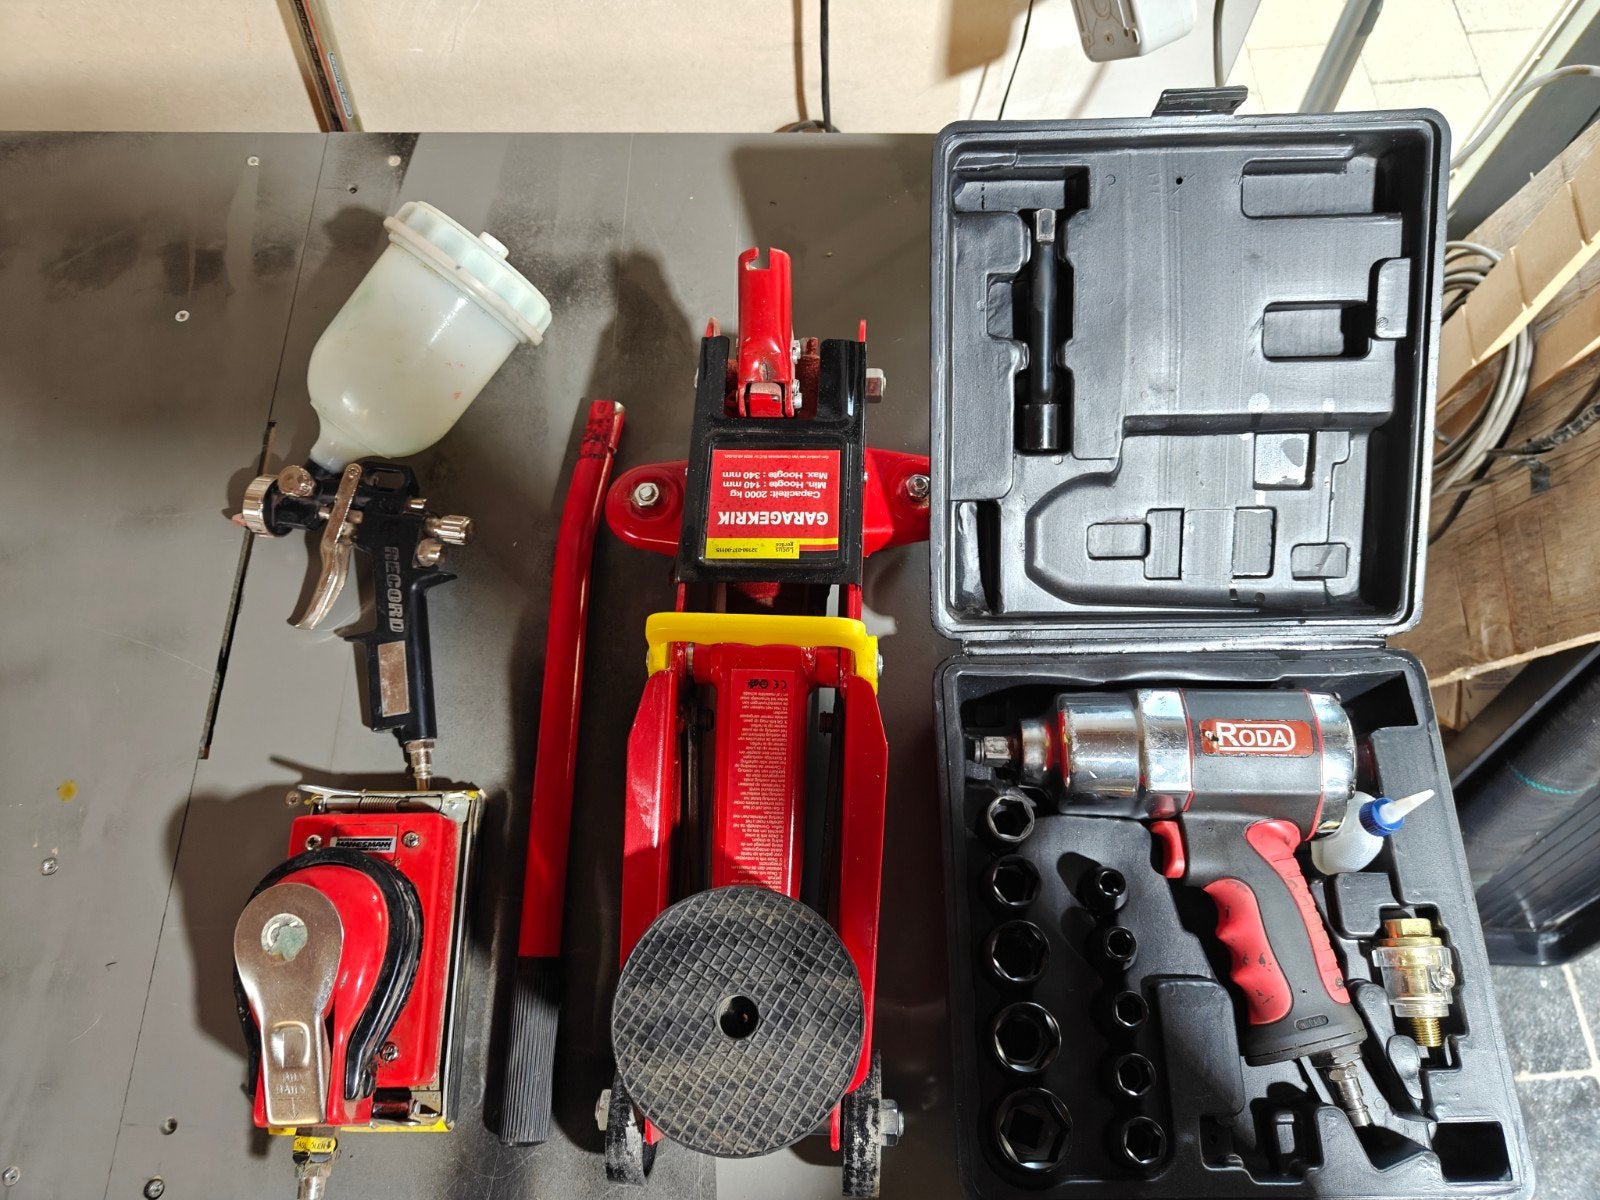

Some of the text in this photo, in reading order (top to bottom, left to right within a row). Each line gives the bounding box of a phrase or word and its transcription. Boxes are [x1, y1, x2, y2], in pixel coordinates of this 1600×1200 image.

[743, 471, 761, 479] 340
[768, 470, 803, 479] Hoogte
[805, 472, 828, 480] Max.
[743, 481, 761, 489] 140
[768, 479, 804, 488] Hoogte
[806, 481, 827, 489] Min.
[729, 489, 821, 499] Capaciteit: 2000 kg
[717, 511, 829, 526] GARAGEKRIK
[1215, 721, 1290, 748] RODA
